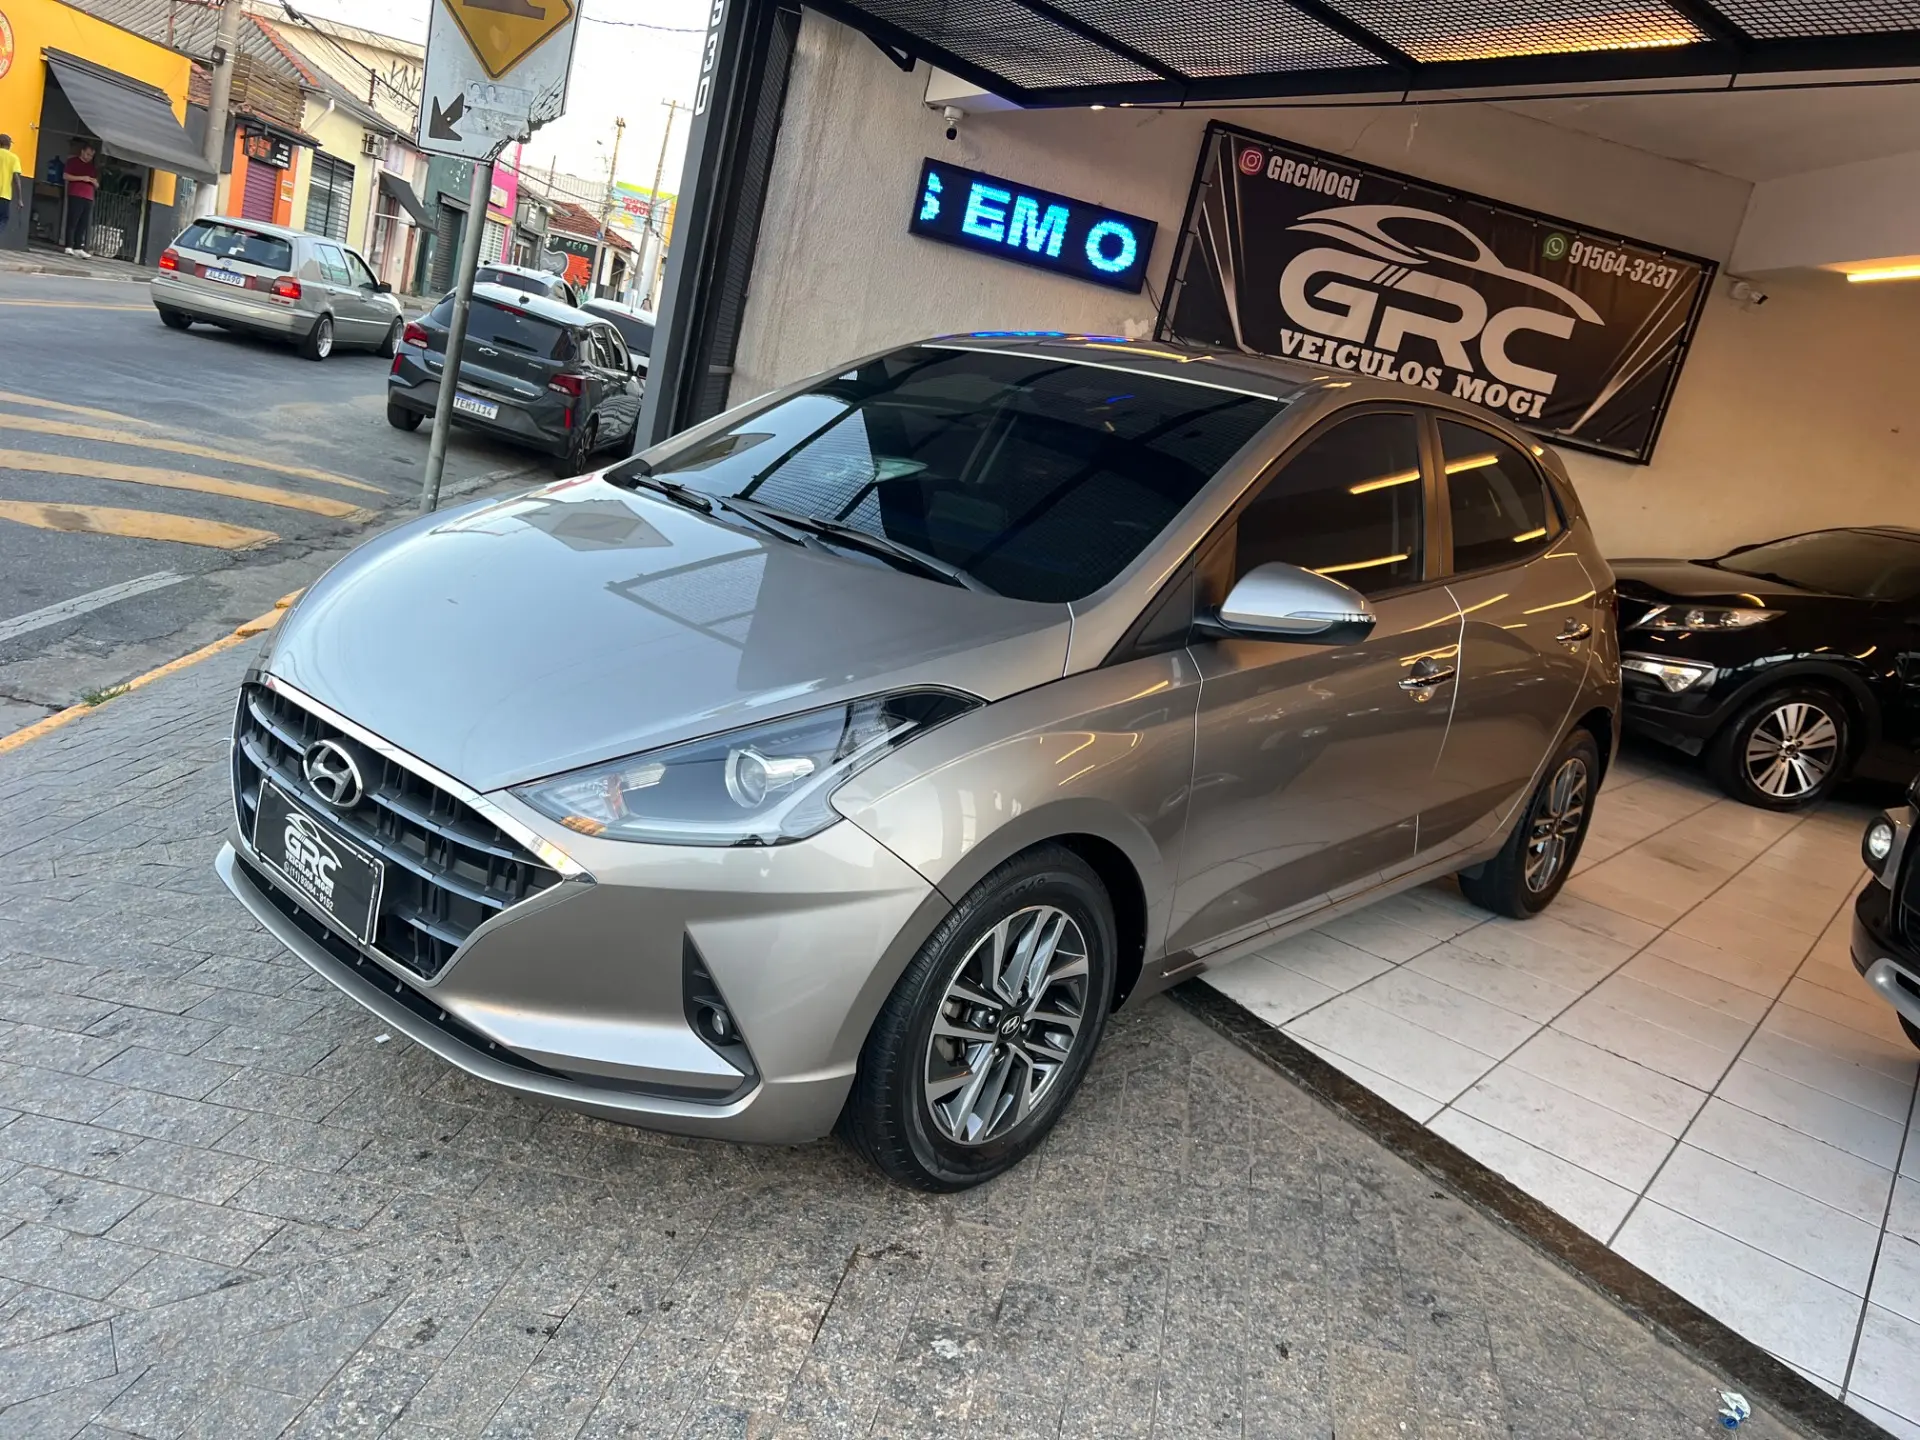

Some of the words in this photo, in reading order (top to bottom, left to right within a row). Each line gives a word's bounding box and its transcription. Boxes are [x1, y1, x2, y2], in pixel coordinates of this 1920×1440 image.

[1267, 155, 1361, 202] GRCMOGI
[961, 182, 1070, 257] EM
[1085, 220, 1137, 273] O
[1568, 240, 1678, 290] 91564-3237
[1280, 247, 1577, 395] GRC
[1279, 329, 1443, 392] VEICULOS
[1451, 374, 1547, 419] MOGI
[284, 825, 337, 890] GRC
